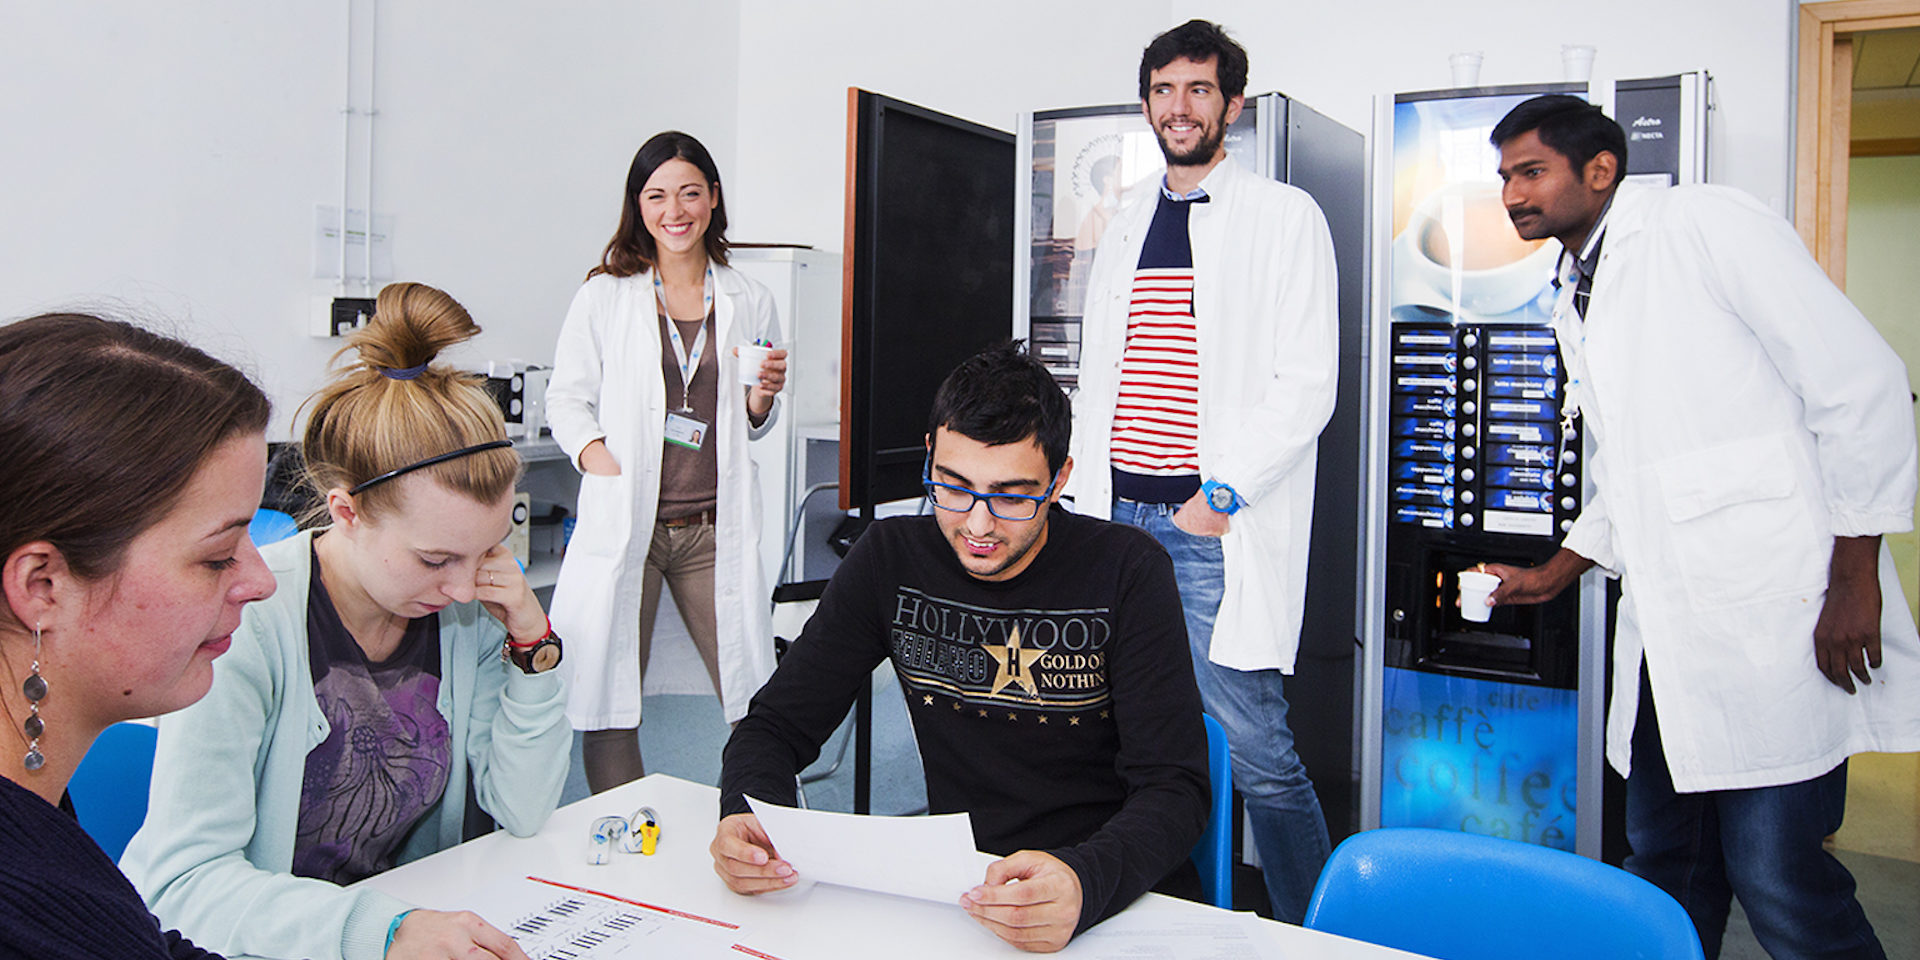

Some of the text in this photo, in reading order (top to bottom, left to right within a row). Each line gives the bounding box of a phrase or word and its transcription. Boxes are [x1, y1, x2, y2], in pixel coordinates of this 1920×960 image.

[892, 594, 1110, 650] HOLLYWOOD
[1007, 647, 1020, 677] H
[1040, 653, 1086, 670] GOLD
[1384, 704, 1496, 750] caffè
